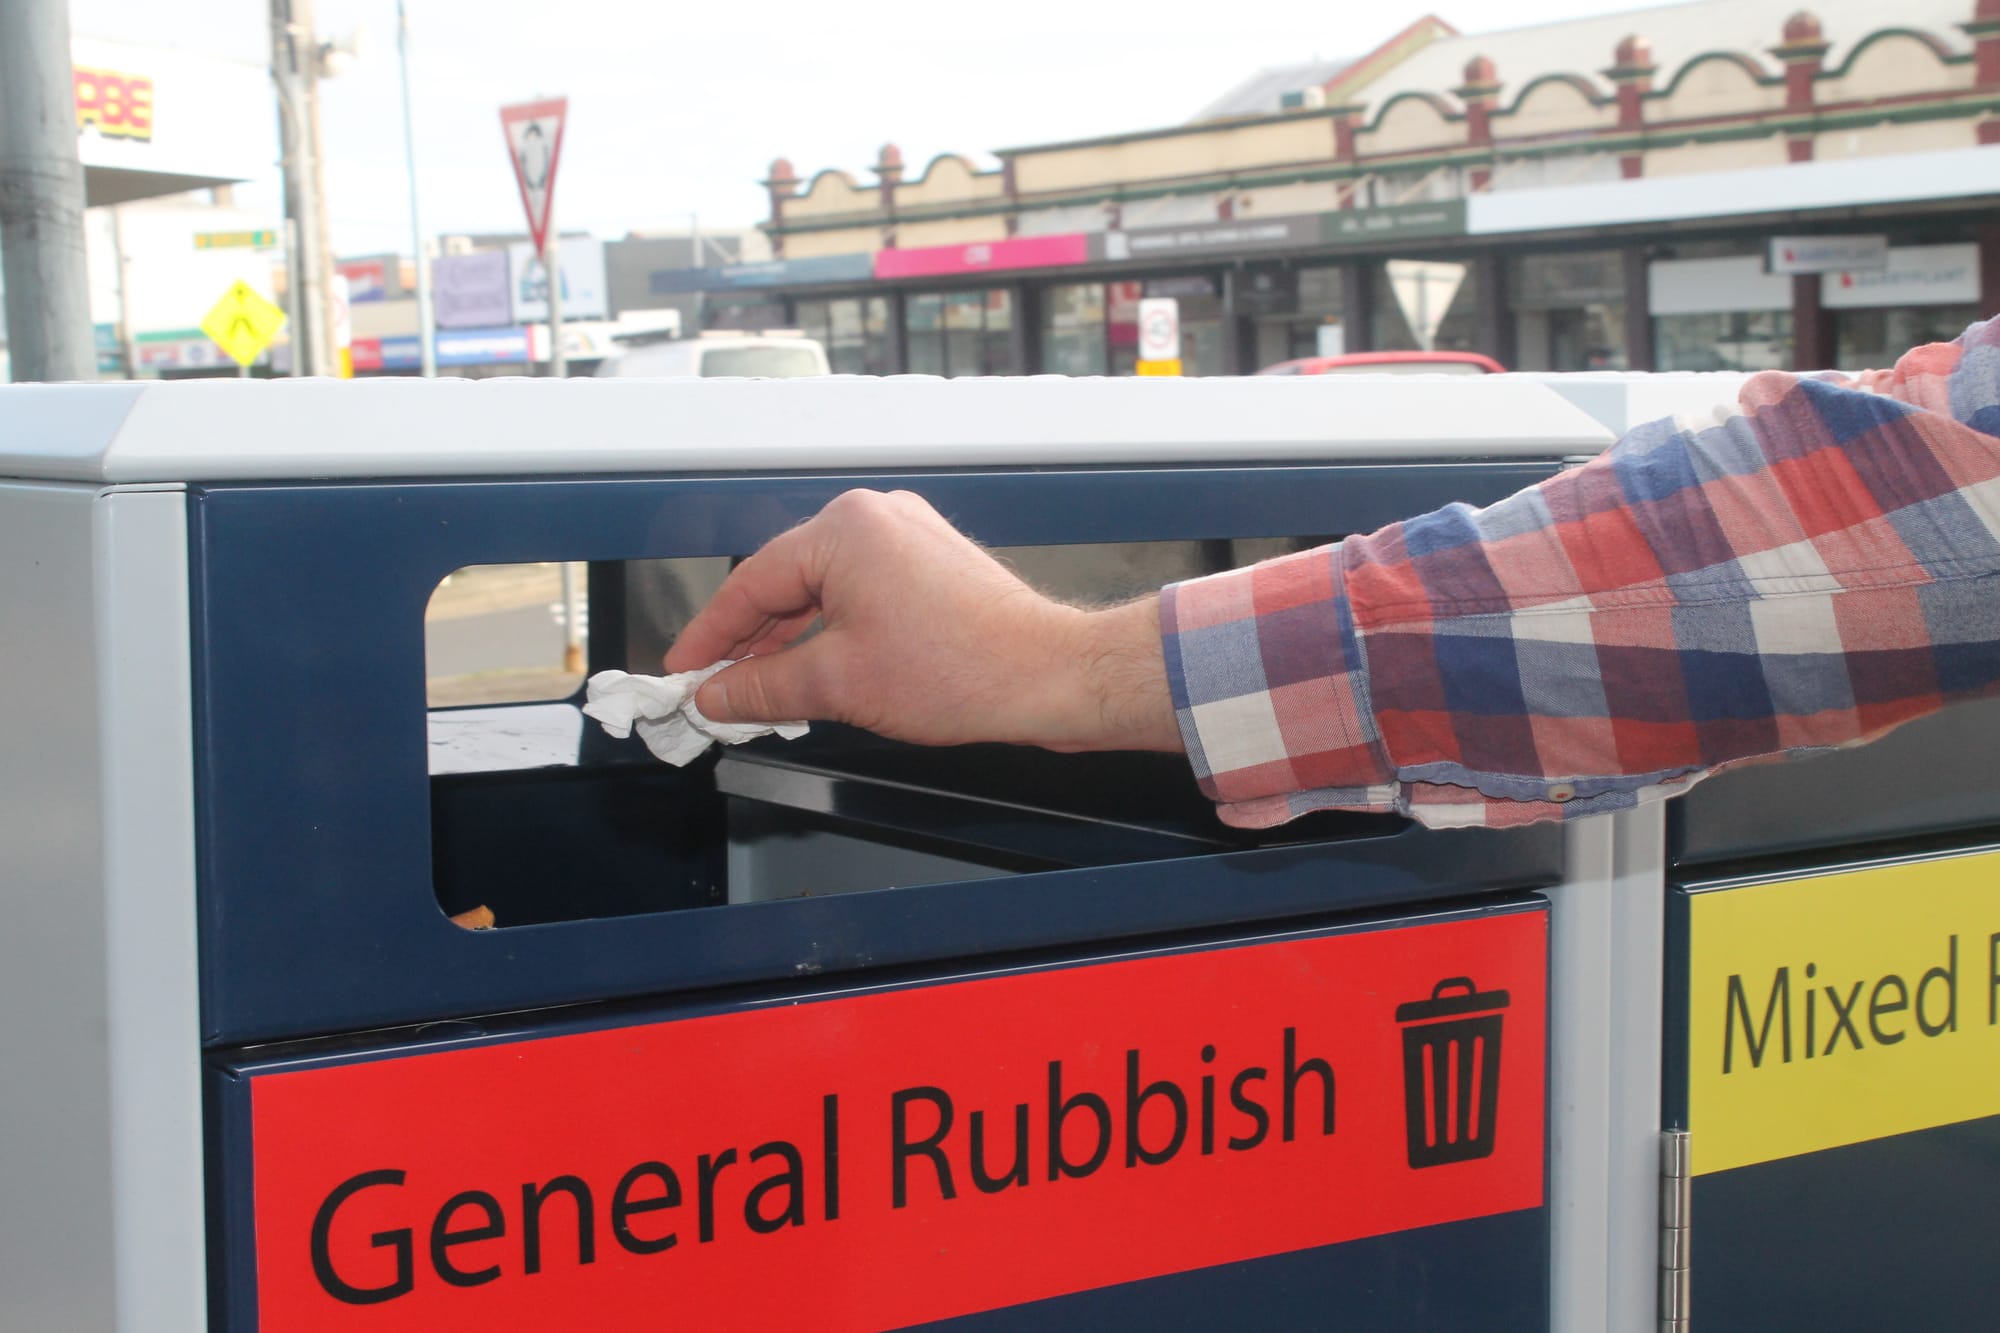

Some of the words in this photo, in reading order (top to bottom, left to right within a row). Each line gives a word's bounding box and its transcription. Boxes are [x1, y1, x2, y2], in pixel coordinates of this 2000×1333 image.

[1722, 934, 1958, 1074] Mixed
[311, 1095, 839, 1305] General
[893, 1028, 1335, 1209] Rubbish
